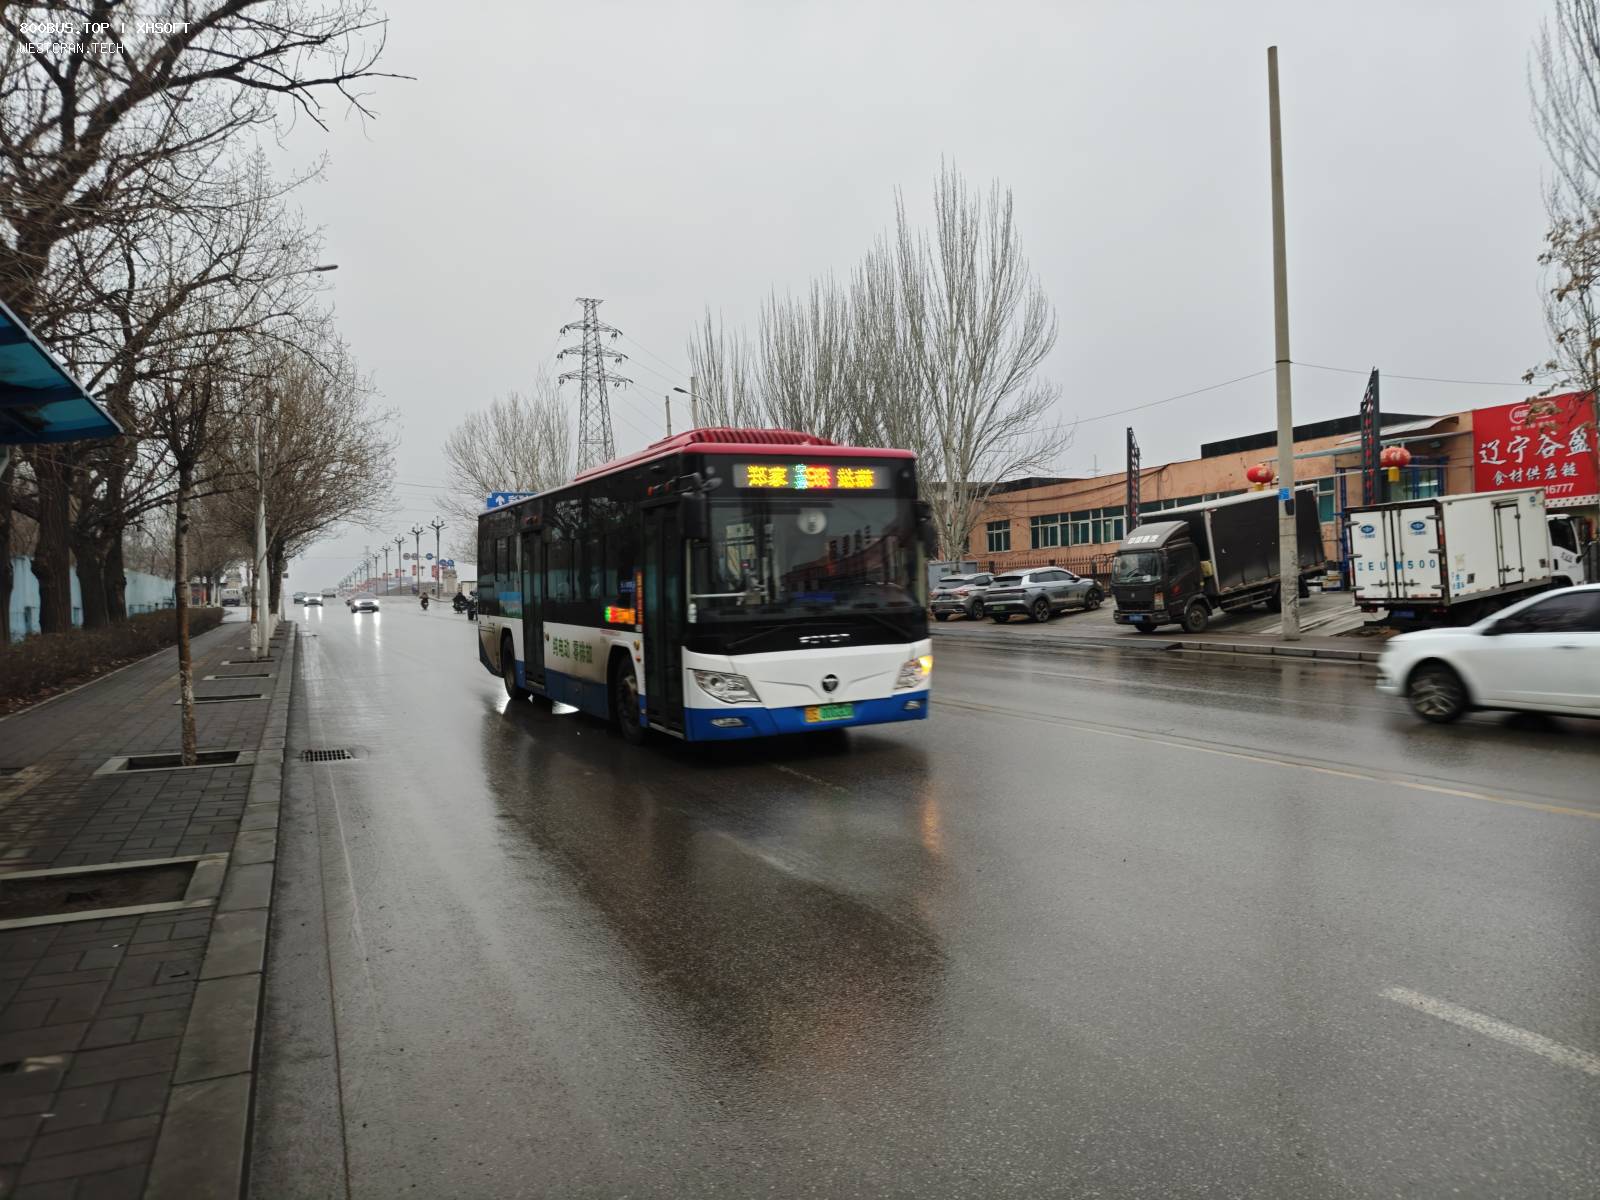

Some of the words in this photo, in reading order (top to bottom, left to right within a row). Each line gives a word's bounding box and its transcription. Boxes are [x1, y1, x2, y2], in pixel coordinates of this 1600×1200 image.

[1493, 462, 1580, 487] 食材供应链
